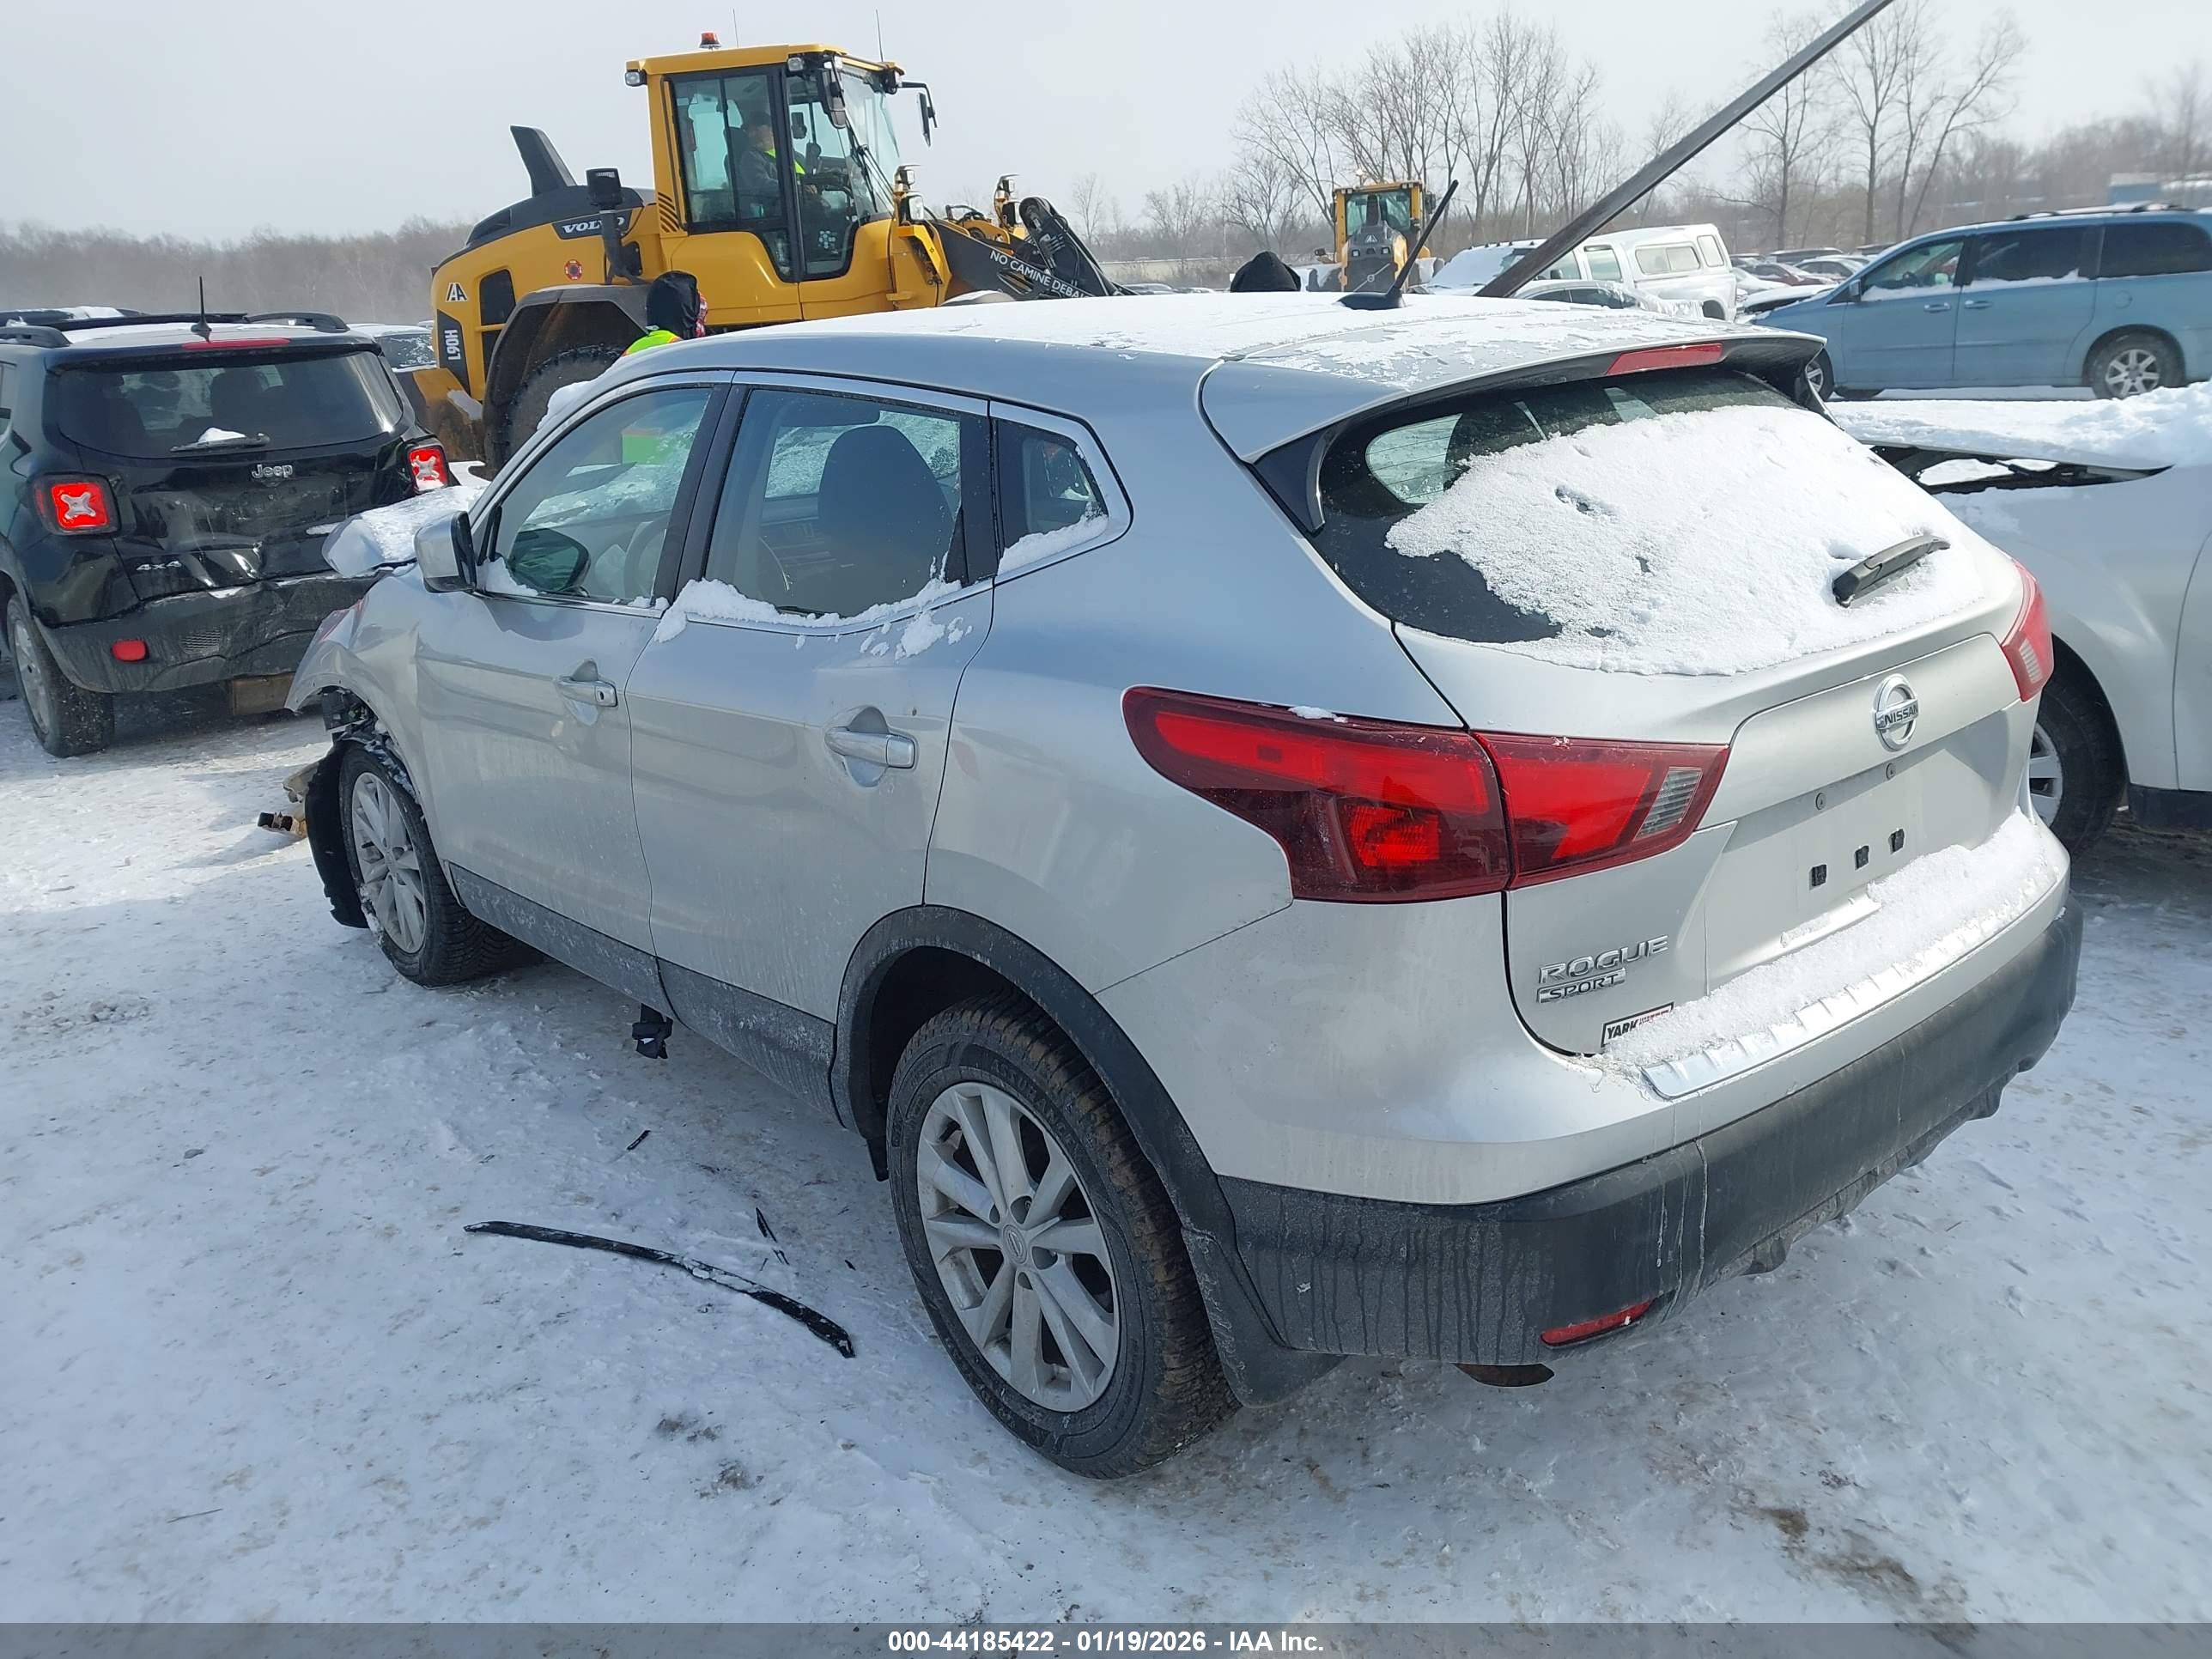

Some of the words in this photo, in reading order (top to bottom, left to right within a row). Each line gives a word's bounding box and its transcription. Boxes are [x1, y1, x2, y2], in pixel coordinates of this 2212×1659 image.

[990, 250, 1008, 265] NO
[1010, 260, 1052, 287] CAMINE
[444, 329, 461, 361] L90H
[251, 464, 294, 479] Jeep
[1884, 704, 1919, 726] NISSAN
[1538, 934, 1669, 984] ROGUE
[1549, 973, 1619, 1000] SPORT
